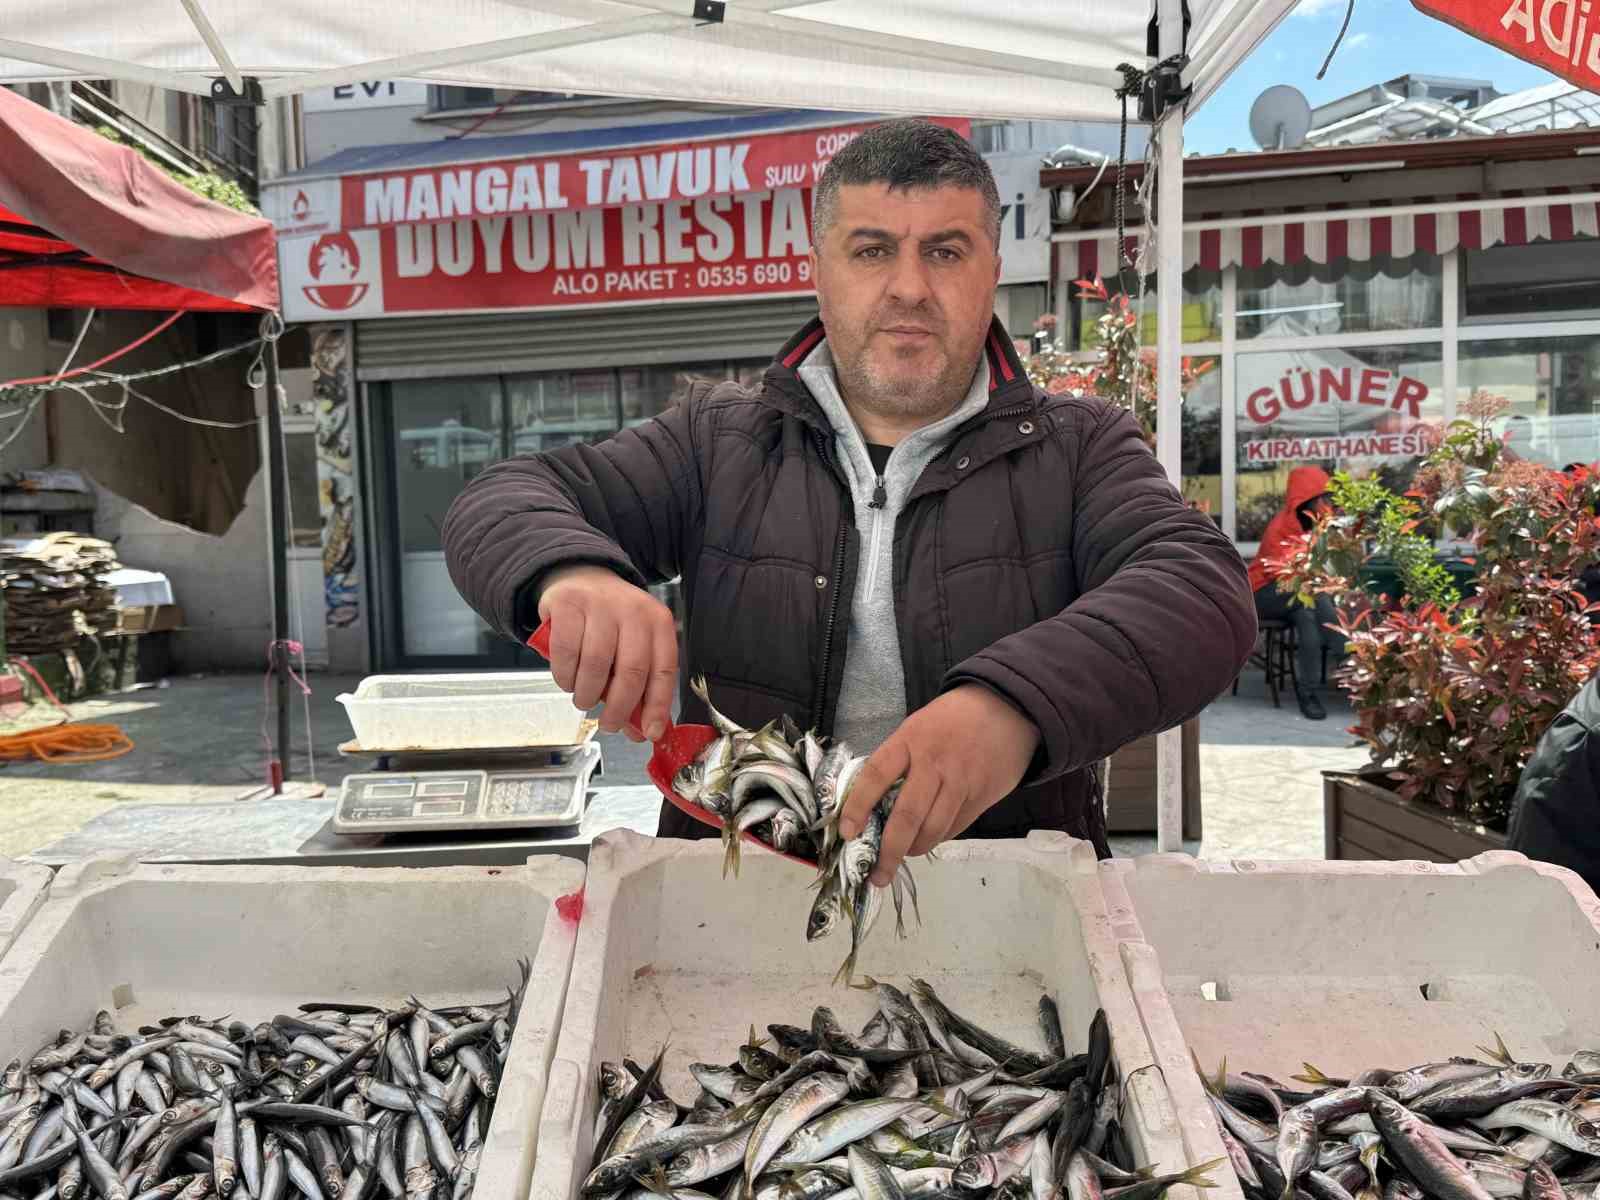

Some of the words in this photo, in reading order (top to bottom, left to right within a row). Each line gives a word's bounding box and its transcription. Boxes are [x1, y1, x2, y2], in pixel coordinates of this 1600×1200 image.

[364, 162, 569, 225] MANGAL
[579, 144, 751, 206] TAVUK
[764, 163, 807, 189] SULU
[620, 187, 817, 267] RESTA
[552, 274, 599, 295] ALO
[604, 269, 678, 292] PAKET
[697, 266, 748, 288] 0535
[753, 263, 791, 284] 690
[1246, 366, 1430, 424] GÜNER
[1247, 431, 1426, 461] KIRAATHANESİ
